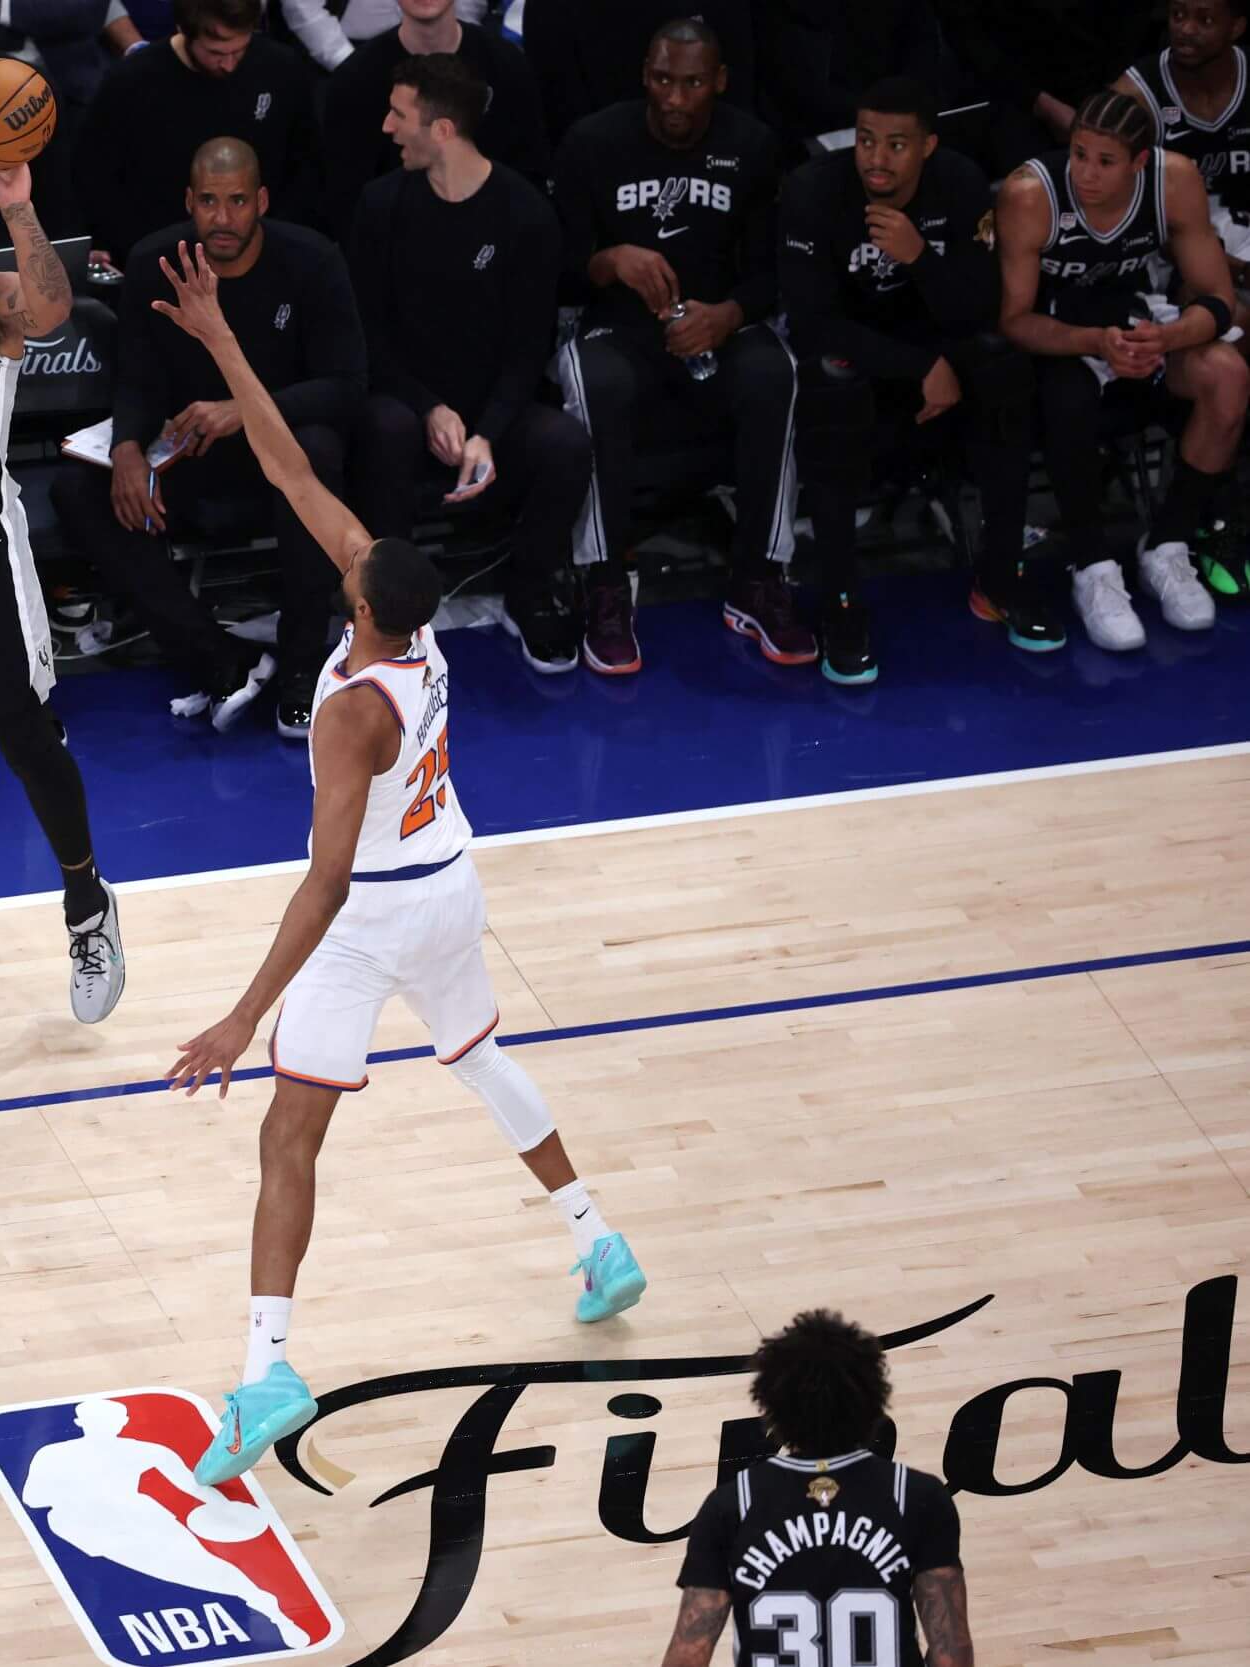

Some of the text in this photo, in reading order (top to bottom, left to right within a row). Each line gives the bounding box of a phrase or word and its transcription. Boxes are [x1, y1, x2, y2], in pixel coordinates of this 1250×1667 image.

[4, 84, 52, 131] Wilson
[616, 177, 731, 215] SPURS
[21, 336, 102, 375] inals
[735, 1511, 910, 1590] CHAMPAGNIE
[118, 1602, 252, 1657] NBA
[749, 1587, 900, 1667] 30
